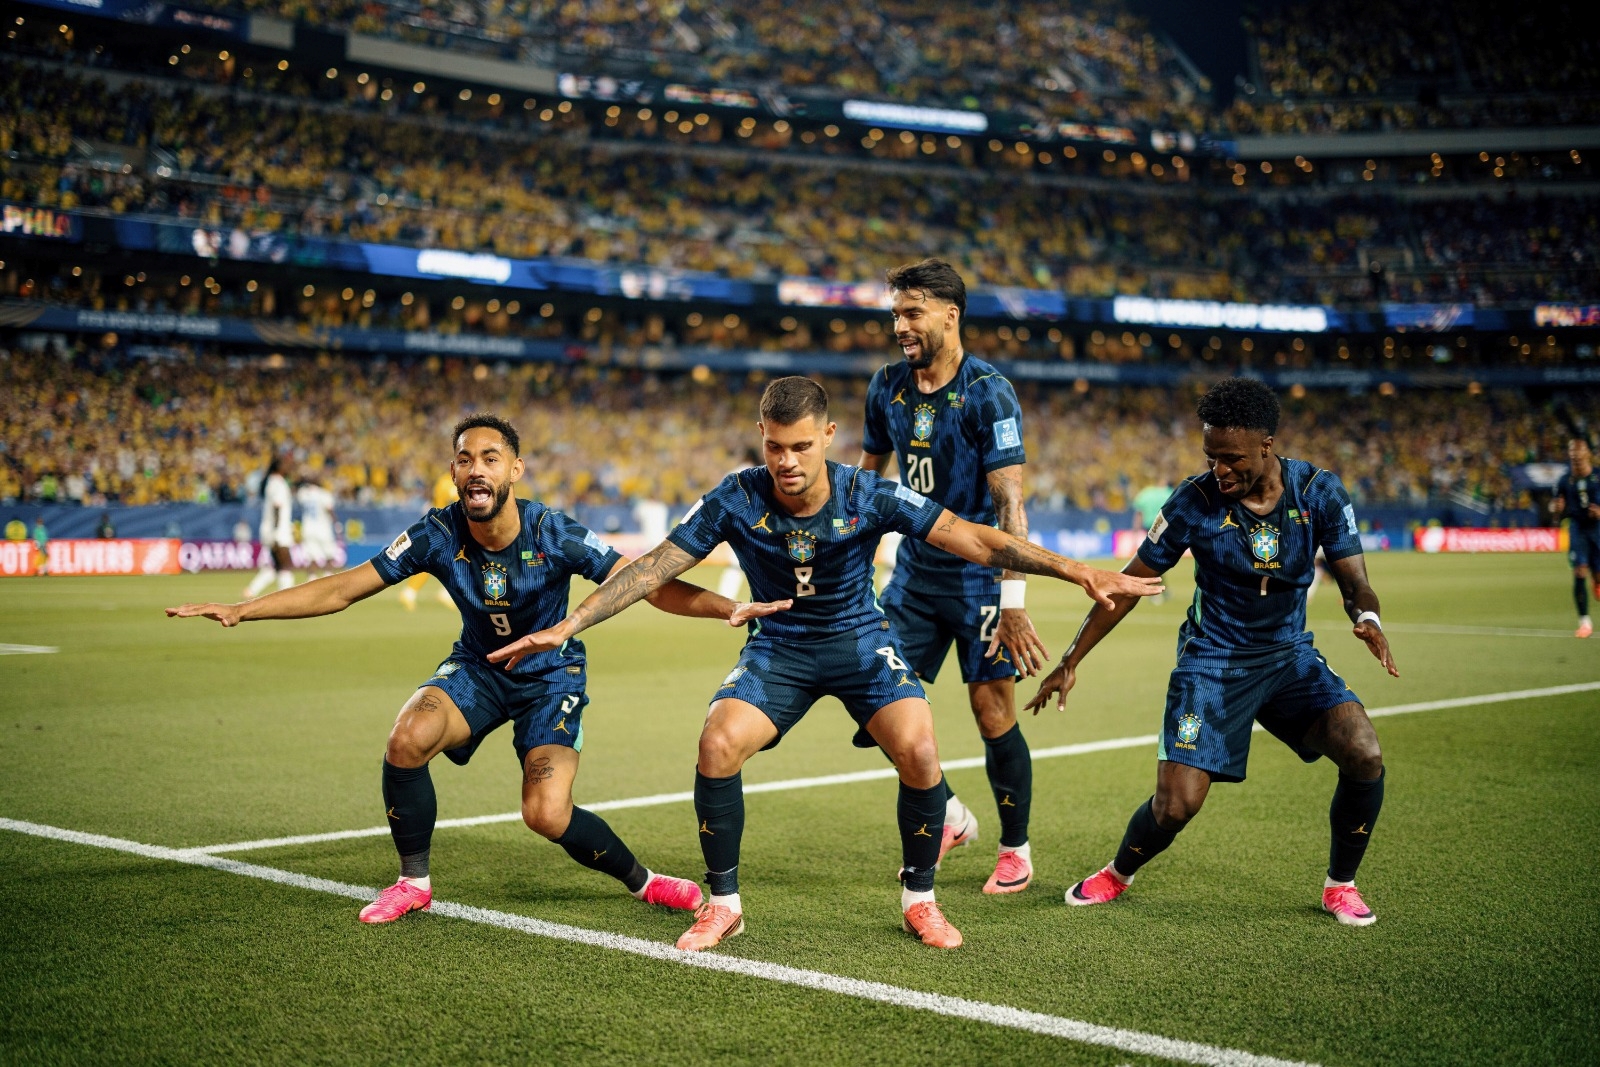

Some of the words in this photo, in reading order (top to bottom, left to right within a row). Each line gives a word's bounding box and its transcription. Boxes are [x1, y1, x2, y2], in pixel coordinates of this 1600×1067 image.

[910, 439, 931, 448] BRASIL
[907, 453, 935, 493] 20
[0, 541, 31, 575] OT
[47, 541, 134, 574] ELIVERS
[1254, 561, 1282, 569] BRASIL
[794, 566, 816, 597] 8
[484, 599, 511, 607] BRASIL
[489, 613, 512, 637] 9
[980, 605, 1002, 641] 2
[876, 646, 909, 670] 8
[1175, 741, 1197, 751] BRASIL
